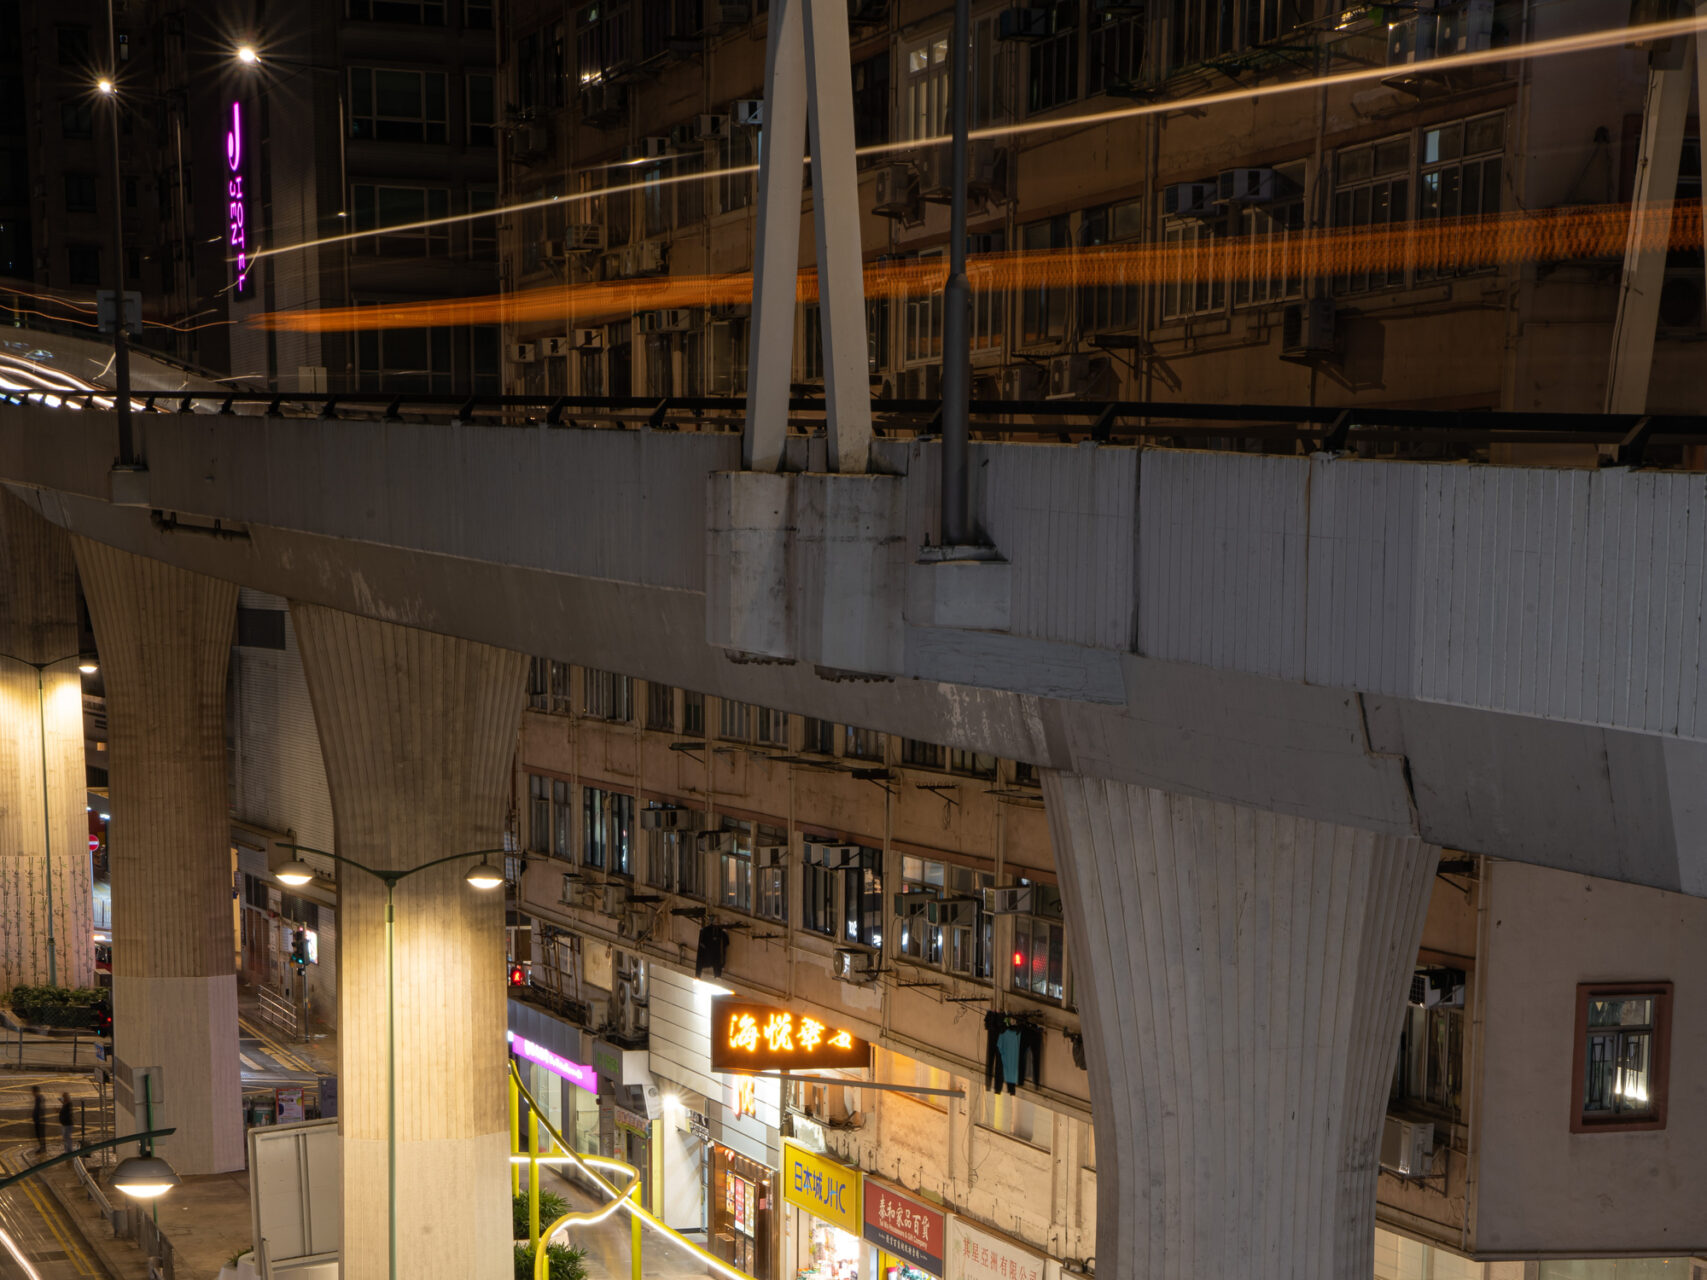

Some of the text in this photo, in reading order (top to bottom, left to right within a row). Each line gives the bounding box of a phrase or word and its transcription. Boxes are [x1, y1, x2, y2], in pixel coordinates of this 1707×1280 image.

[229, 180, 238, 245] JEN
[236, 176, 246, 292] HOTEL
[794, 1161, 823, 1201] 日本城
[823, 1176, 846, 1214] JHC
[878, 1193, 930, 1242] 泰和家品百貨
